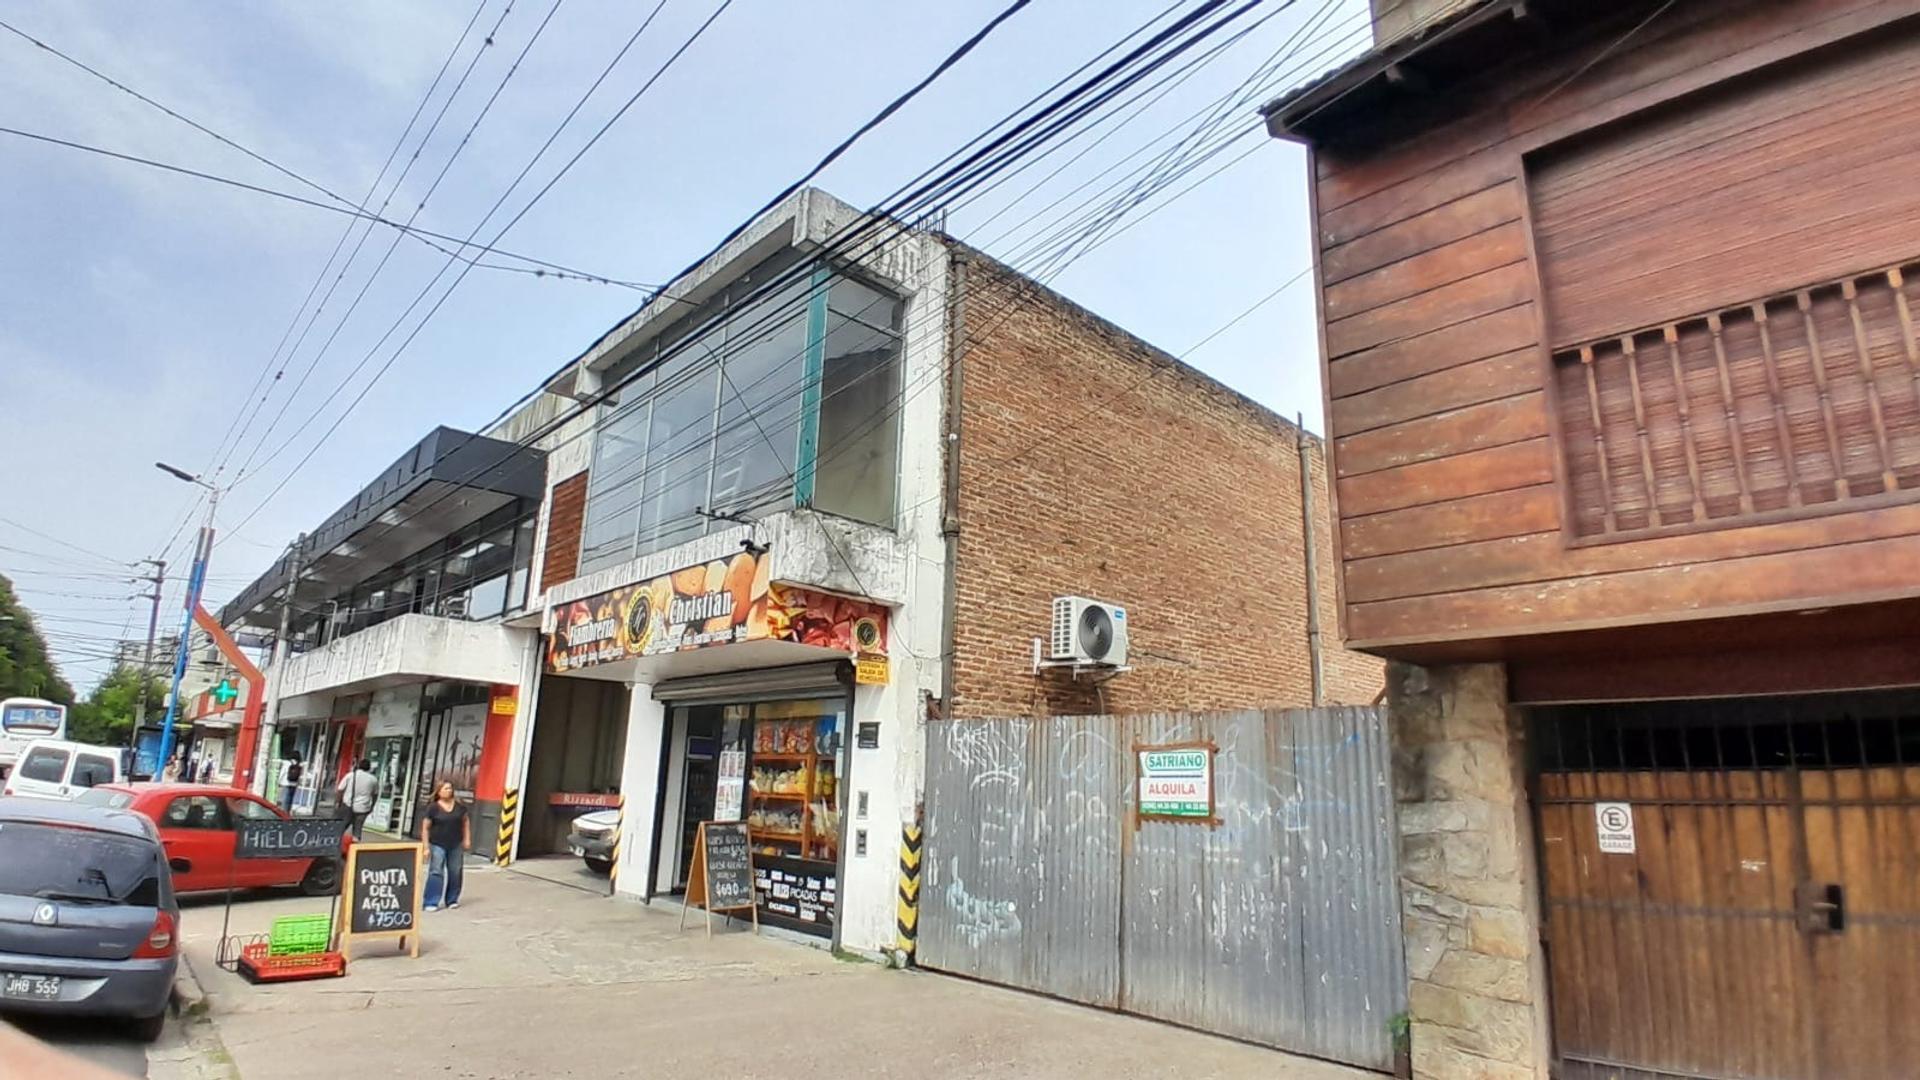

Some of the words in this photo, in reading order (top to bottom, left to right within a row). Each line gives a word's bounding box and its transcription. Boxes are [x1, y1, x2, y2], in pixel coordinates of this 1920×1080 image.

[1148, 754, 1203, 768] SATRIANO
[1147, 783, 1196, 795] ALQUILA
[1608, 812, 1621, 826] E
[361, 868, 408, 886] PUNTA
[369, 884, 397, 899] DEL
[362, 896, 400, 913] AGUA
[368, 911, 412, 927] $7500
[35, 980, 59, 994] 555
